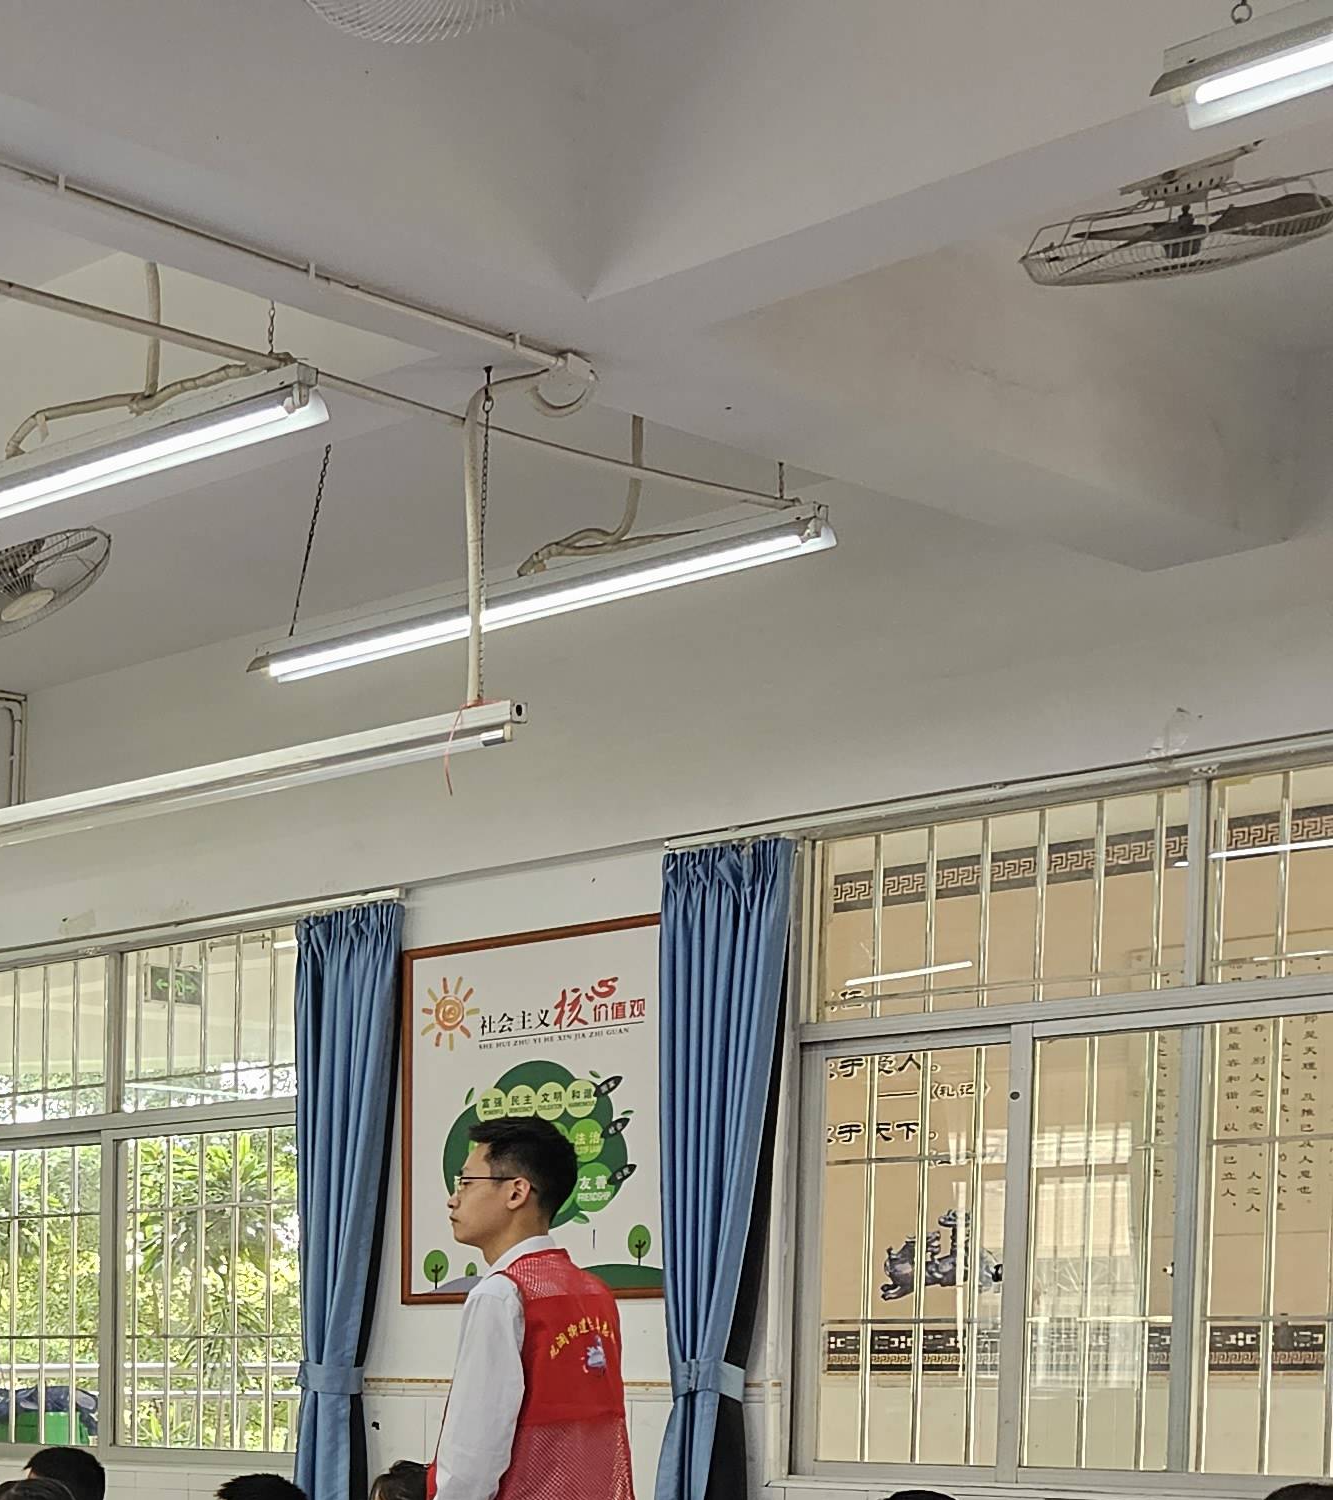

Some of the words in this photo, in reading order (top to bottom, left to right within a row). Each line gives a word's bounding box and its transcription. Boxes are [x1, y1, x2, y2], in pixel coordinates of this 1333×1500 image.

[511, 1095, 533, 1106] 民主
[541, 1091, 563, 1104] 文明
[575, 1131, 601, 1145] 法治
[579, 1175, 607, 1189] 友善
